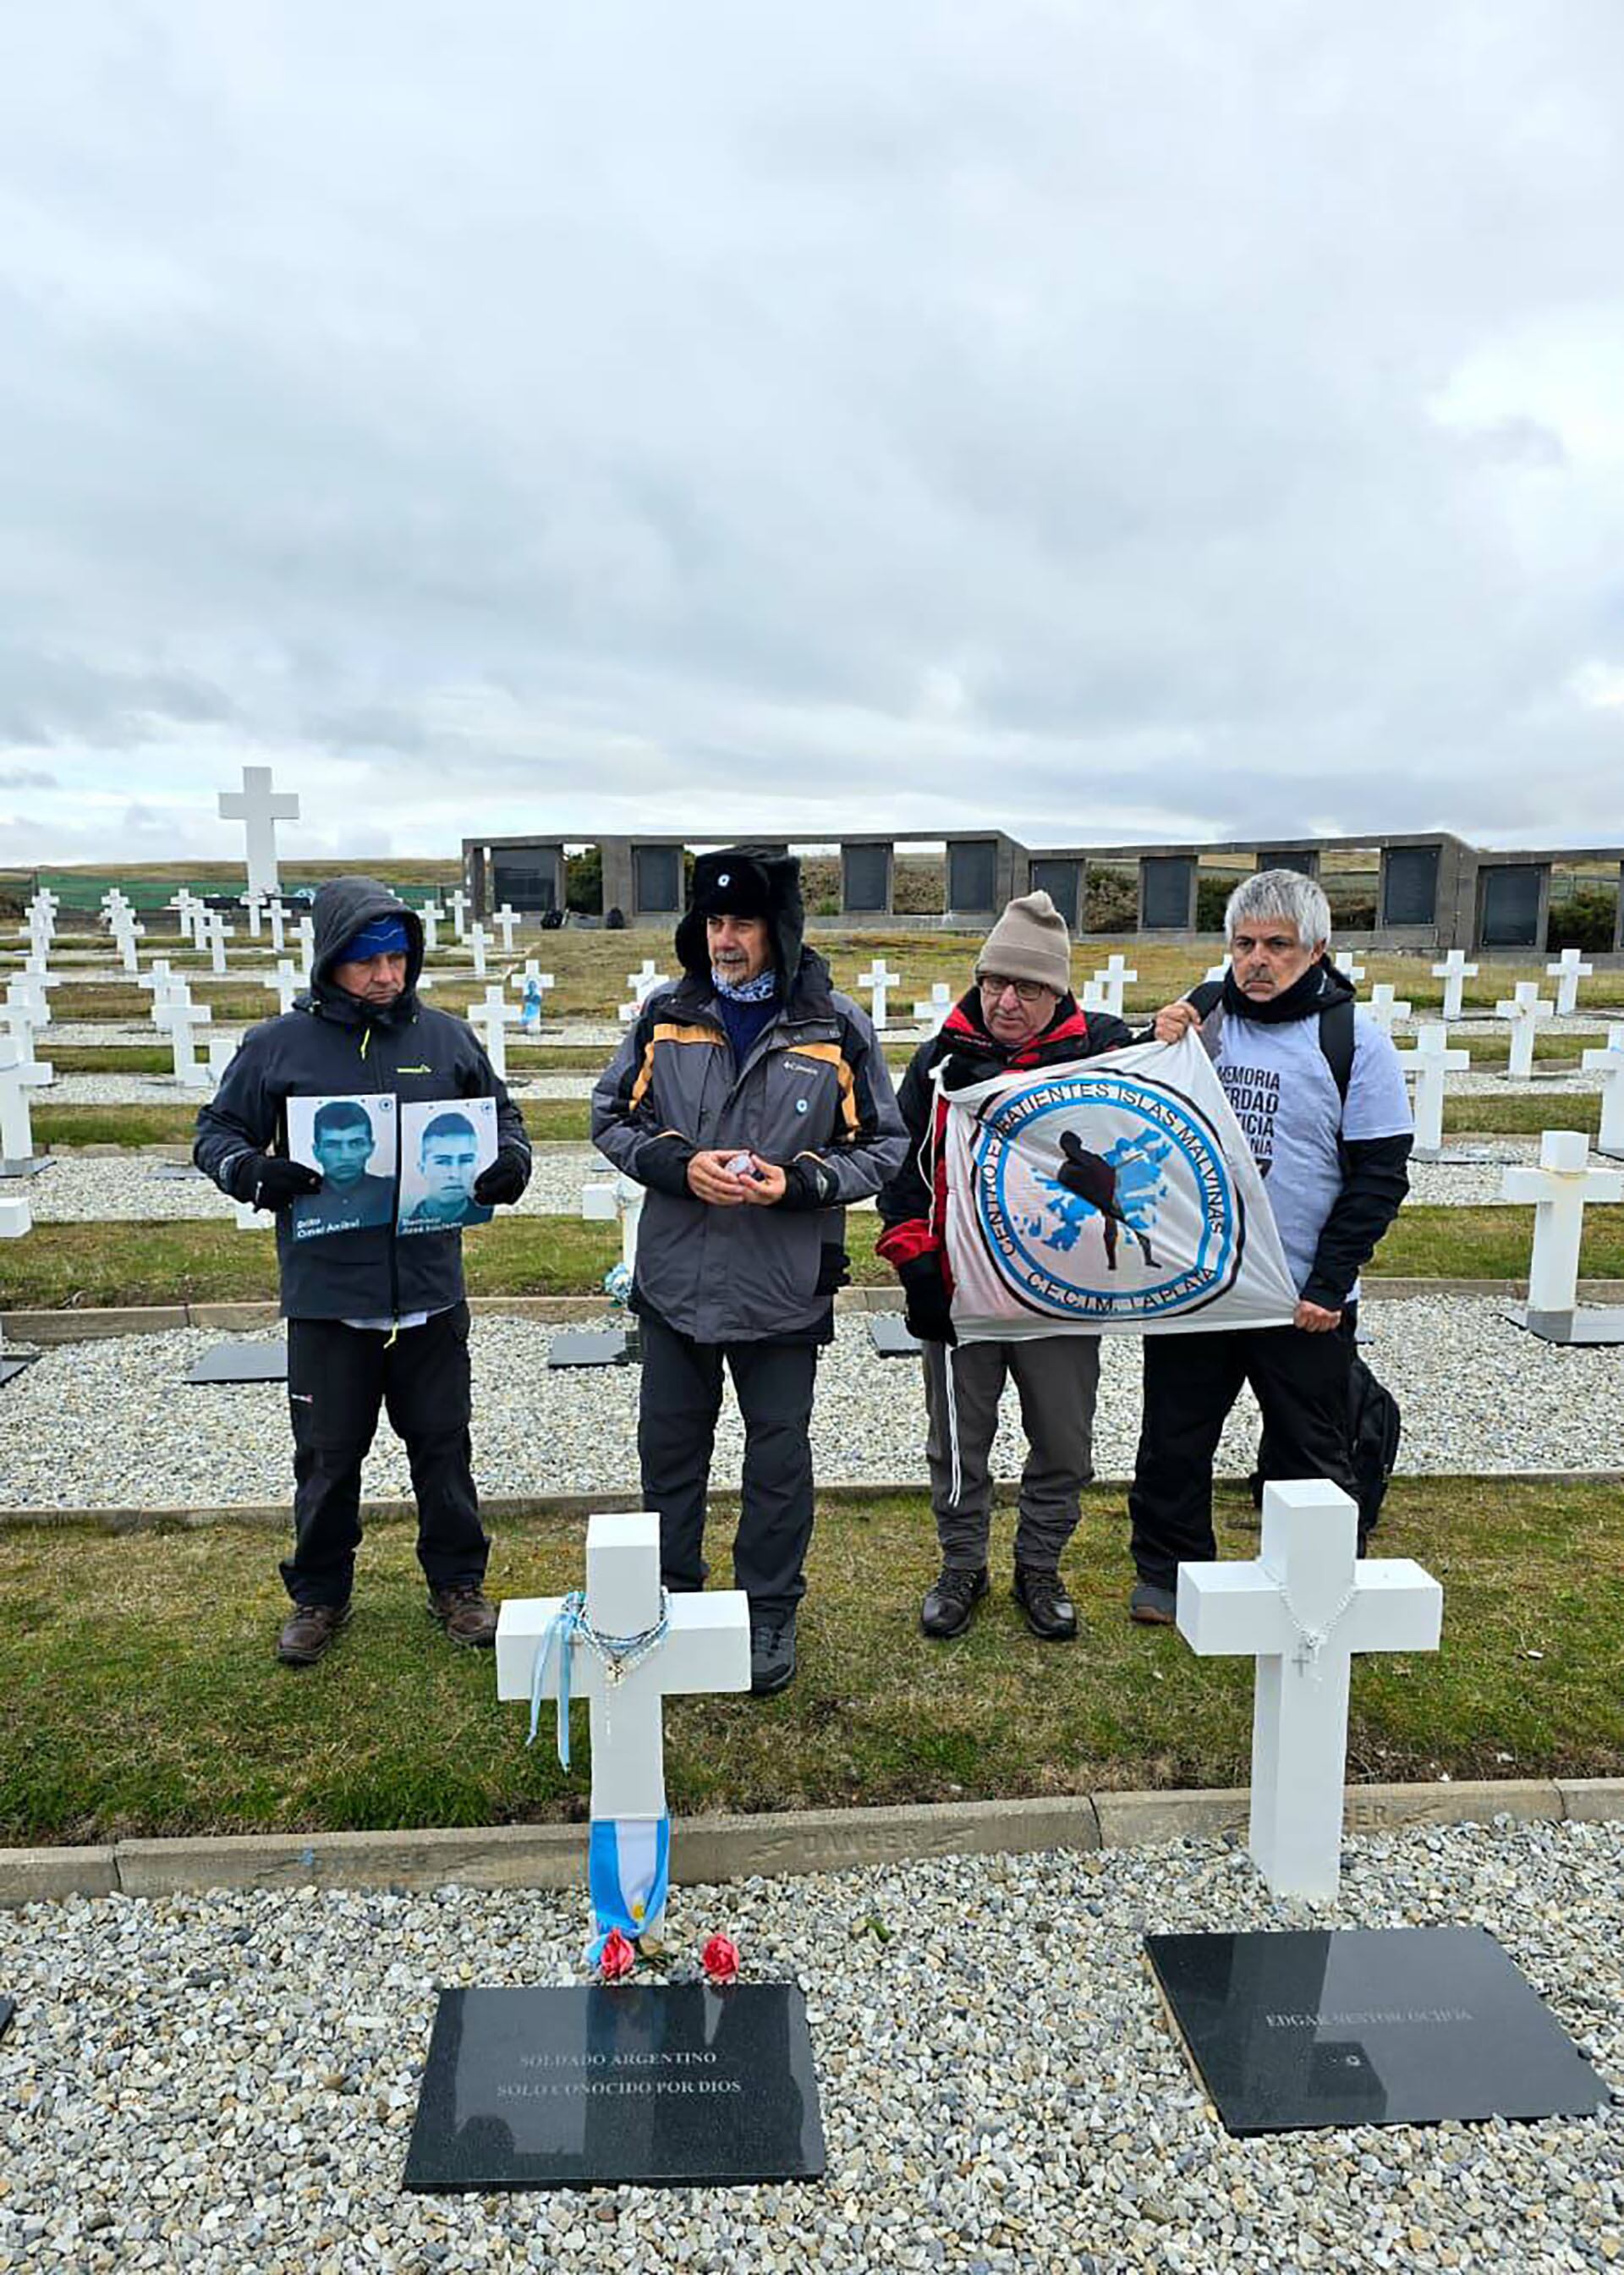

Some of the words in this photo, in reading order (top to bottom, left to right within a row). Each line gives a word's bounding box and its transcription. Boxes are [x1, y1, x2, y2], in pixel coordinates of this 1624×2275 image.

[1223, 1087, 1279, 1114] ERDAD
[1117, 1086, 1178, 1127] ISLAS
[1177, 1126, 1225, 1234] MALVINAS
[520, 2053, 606, 2066] SOLDADO
[611, 2052, 717, 2065] ARGENTINO
[551, 2081, 652, 2095] CONOCIDO
[656, 2081, 694, 2094] POR
[699, 2080, 742, 2093] DIOS
